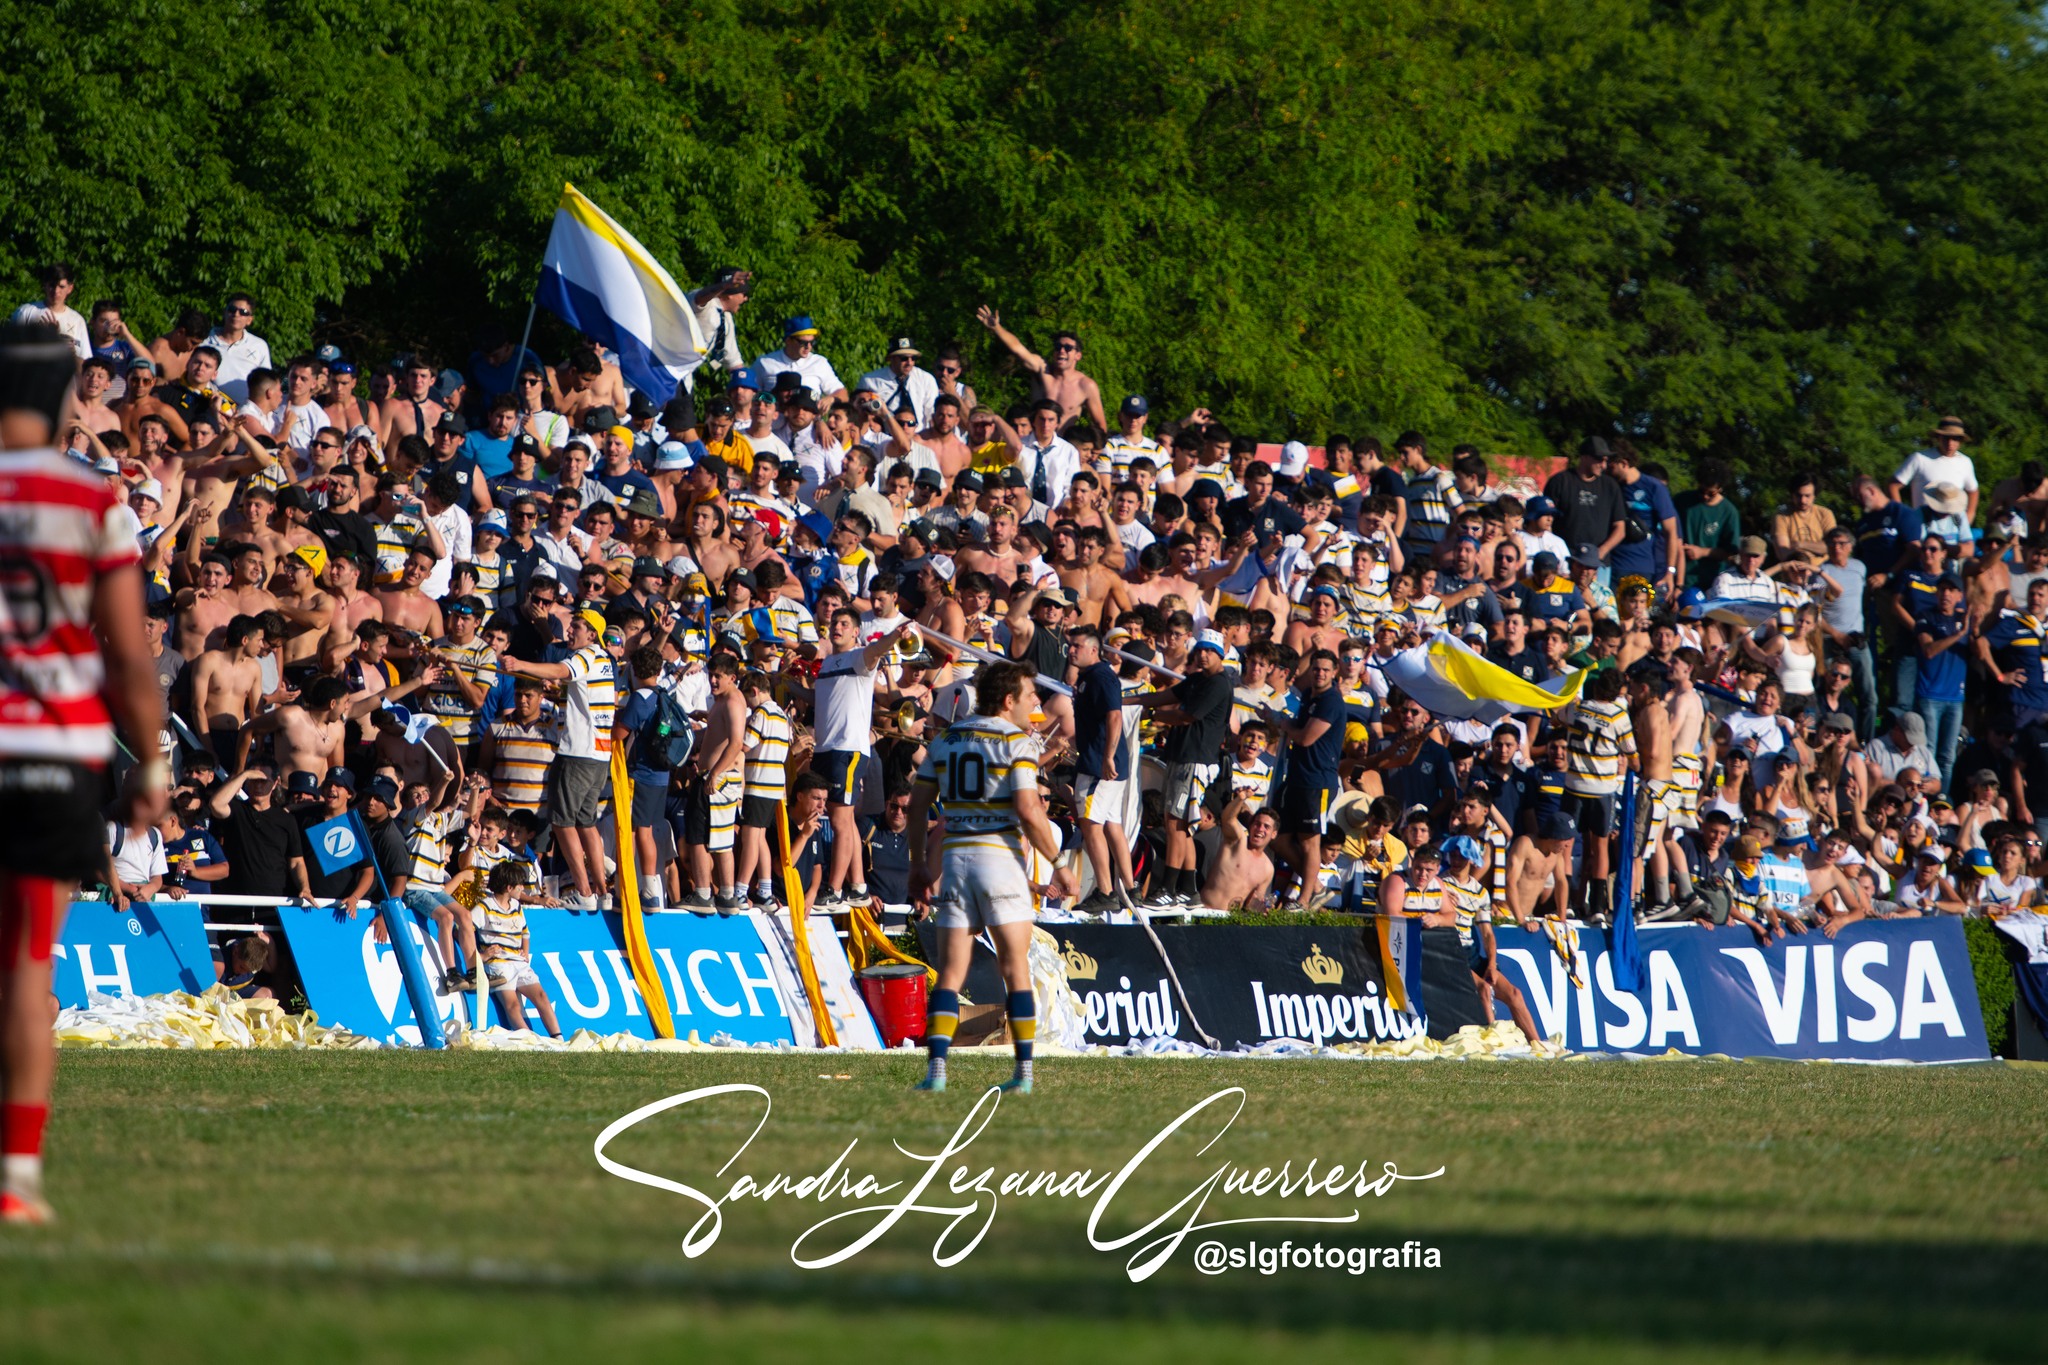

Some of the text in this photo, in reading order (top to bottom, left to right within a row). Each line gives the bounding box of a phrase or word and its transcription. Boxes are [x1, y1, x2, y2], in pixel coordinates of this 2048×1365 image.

[948, 751, 985, 800] 10
[963, 732, 1003, 745] Macro
[1497, 948, 1701, 1048] VISA
[1719, 940, 1967, 1045] VISA
